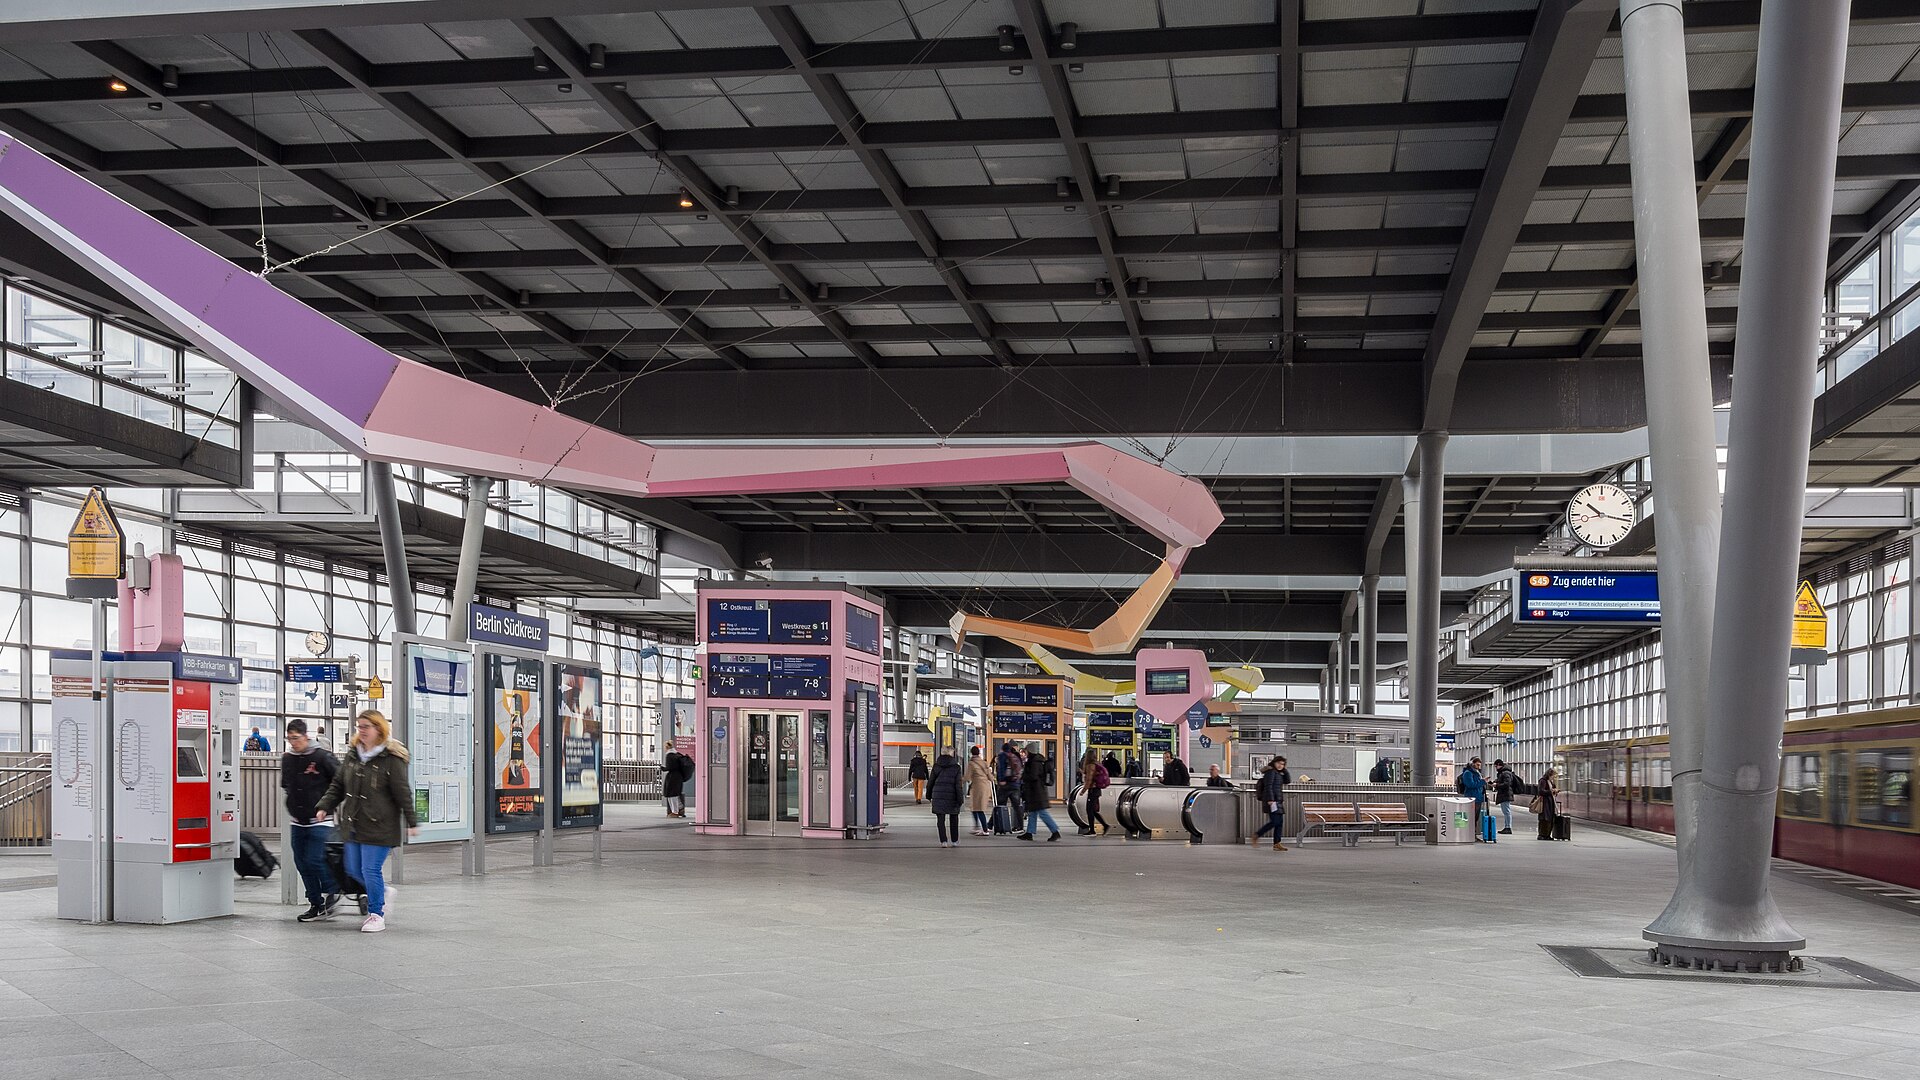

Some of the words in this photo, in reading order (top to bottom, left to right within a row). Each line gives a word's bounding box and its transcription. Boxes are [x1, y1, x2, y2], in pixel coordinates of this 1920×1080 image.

[1532, 577, 1547, 585] S45
[1552, 576, 1570, 588] Zug
[1571, 576, 1597, 586] endet
[1598, 576, 1616, 586] hier
[476, 612, 502, 634] Berlin
[503, 617, 542, 641] Südkreuz
[781, 622, 811, 630] Westkreuz
[820, 621, 829, 631] 11
[182, 658, 226, 672] VBB-Fahrkarten
[517, 673, 537, 687] AXE
[720, 677, 735, 686] 7-8
[804, 679, 819, 688] 7-8
[331, 695, 342, 704] 12
[859, 698, 868, 744] Information
[1138, 714, 1151, 723] 7-8
